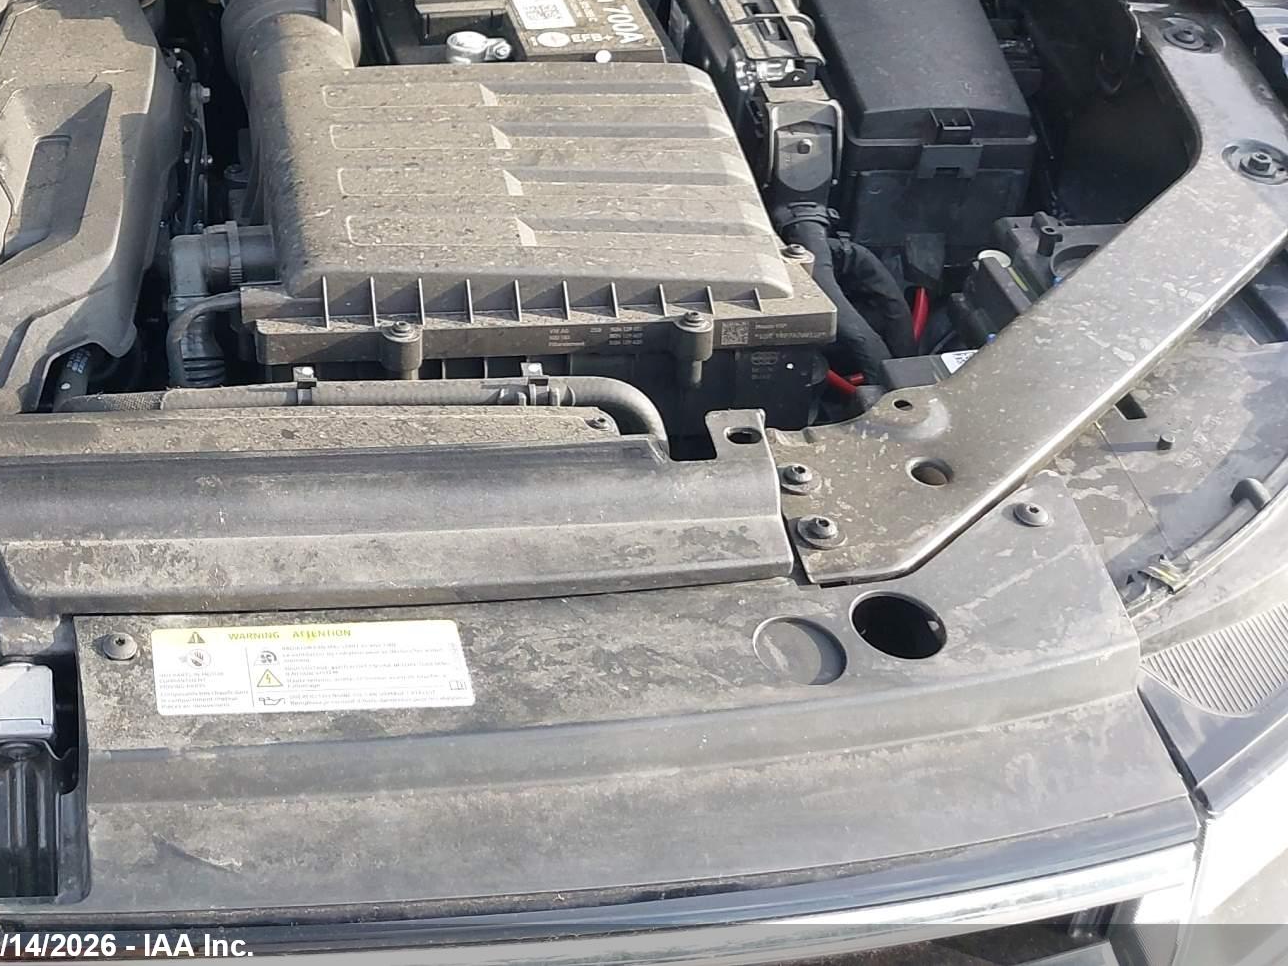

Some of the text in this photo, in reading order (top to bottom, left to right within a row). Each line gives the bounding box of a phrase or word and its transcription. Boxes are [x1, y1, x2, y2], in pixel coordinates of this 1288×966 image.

[603, 4, 644, 44] 700A
[227, 629, 351, 640] WARNING ATTENTION
